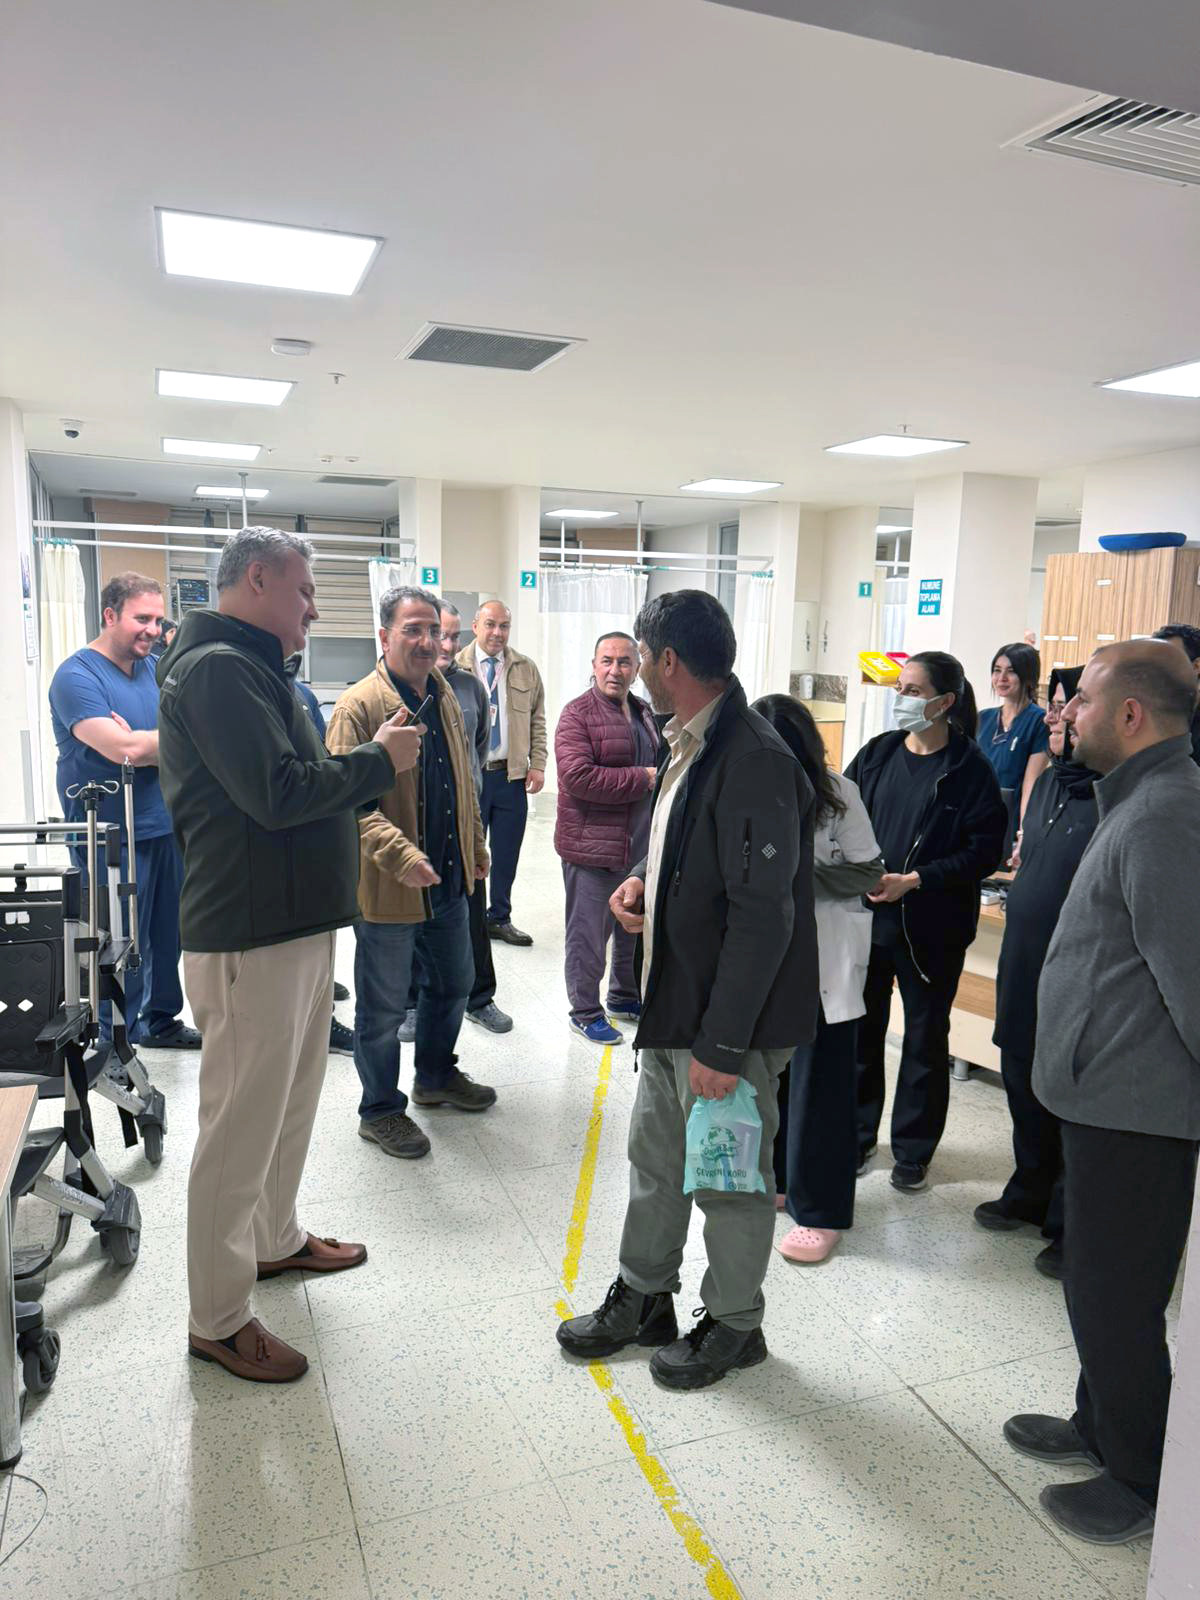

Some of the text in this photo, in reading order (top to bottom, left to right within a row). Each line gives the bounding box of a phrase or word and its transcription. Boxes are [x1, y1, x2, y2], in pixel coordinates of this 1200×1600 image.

[426, 570, 435, 583] 3
[525, 573, 533, 586] 2
[863, 584, 868, 595] 1
[727, 1169, 747, 1178] KORU
